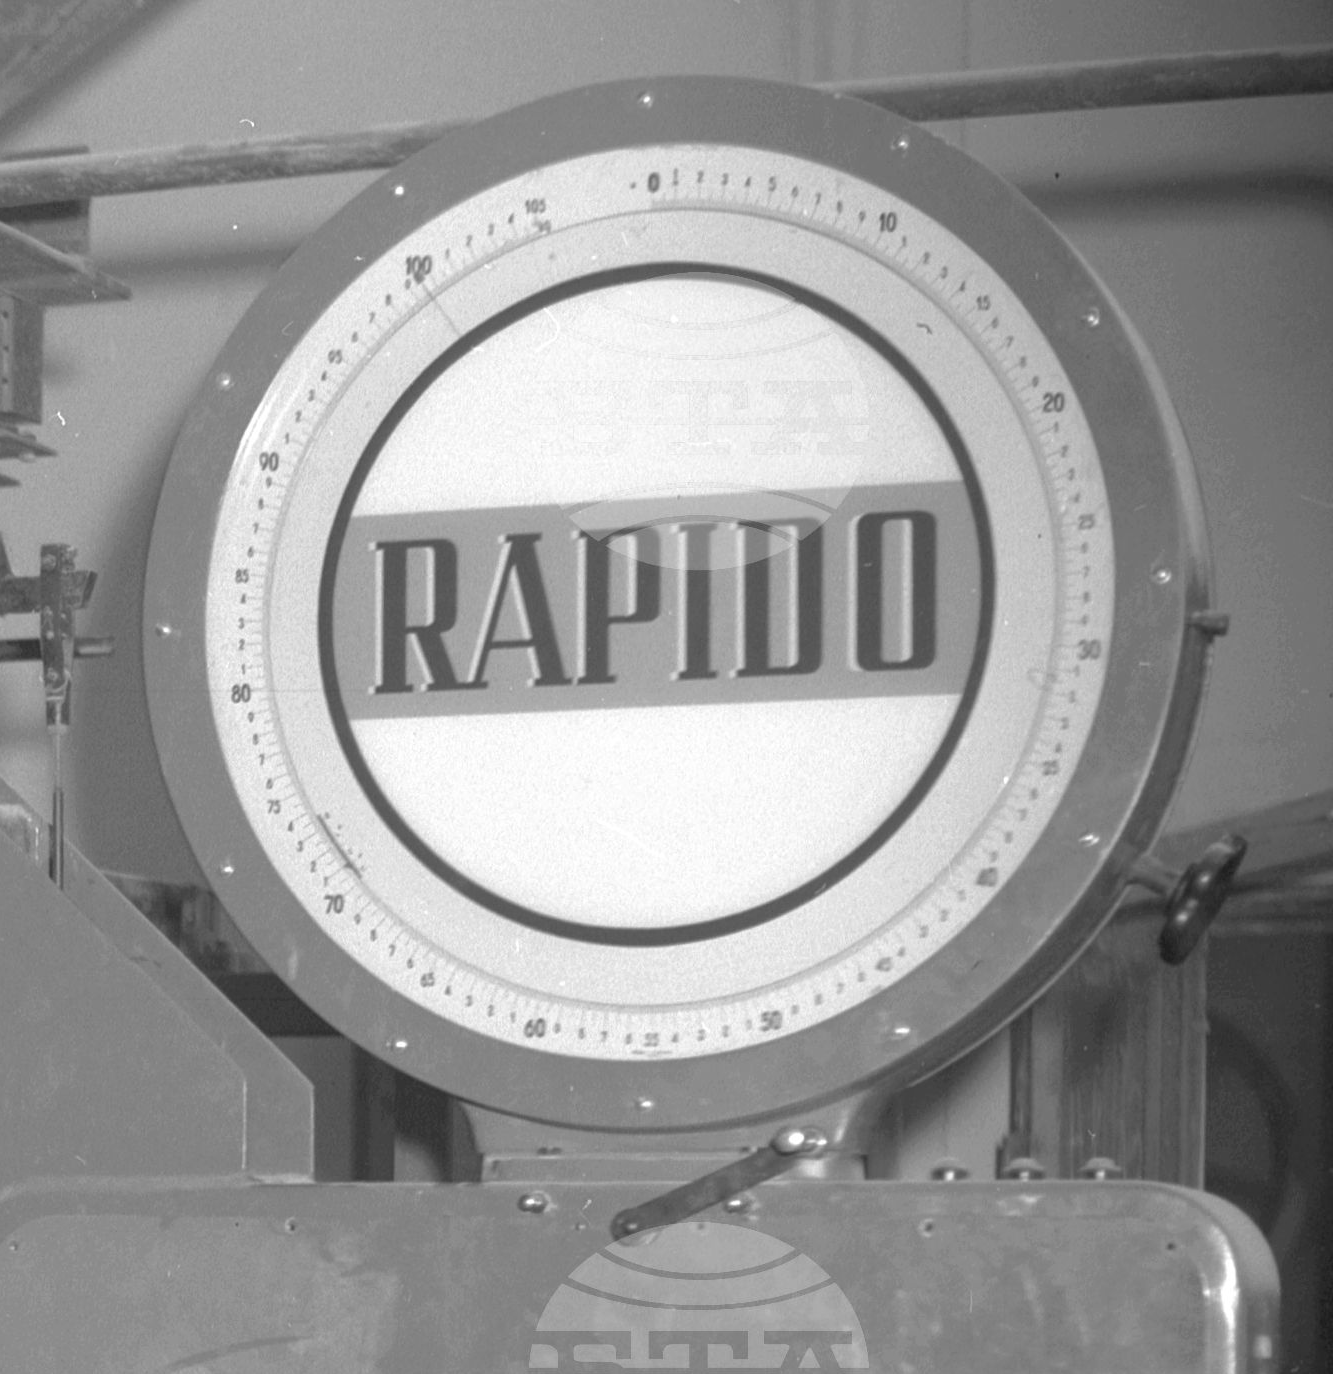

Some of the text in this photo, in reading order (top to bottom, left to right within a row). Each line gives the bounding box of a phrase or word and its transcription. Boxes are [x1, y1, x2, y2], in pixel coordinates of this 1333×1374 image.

[647, 172, 660, 193] 0
[525, 198, 546, 214] 105
[879, 212, 897, 232] 10
[405, 255, 432, 275] 100
[976, 295, 991, 311] 15
[328, 349, 343, 364] 95
[1043, 392, 1065, 413] 20
[259, 452, 279, 472] 90
[235, 569, 249, 583] 85
[368, 510, 936, 694] RAPIDO
[1078, 639, 1102, 660] 30
[231, 683, 253, 703] 80
[267, 799, 281, 814] 75
[324, 894, 345, 914] 70
[420, 971, 435, 988] 65
[524, 1018, 546, 1038] 60
[760, 1010, 782, 1032] 50
